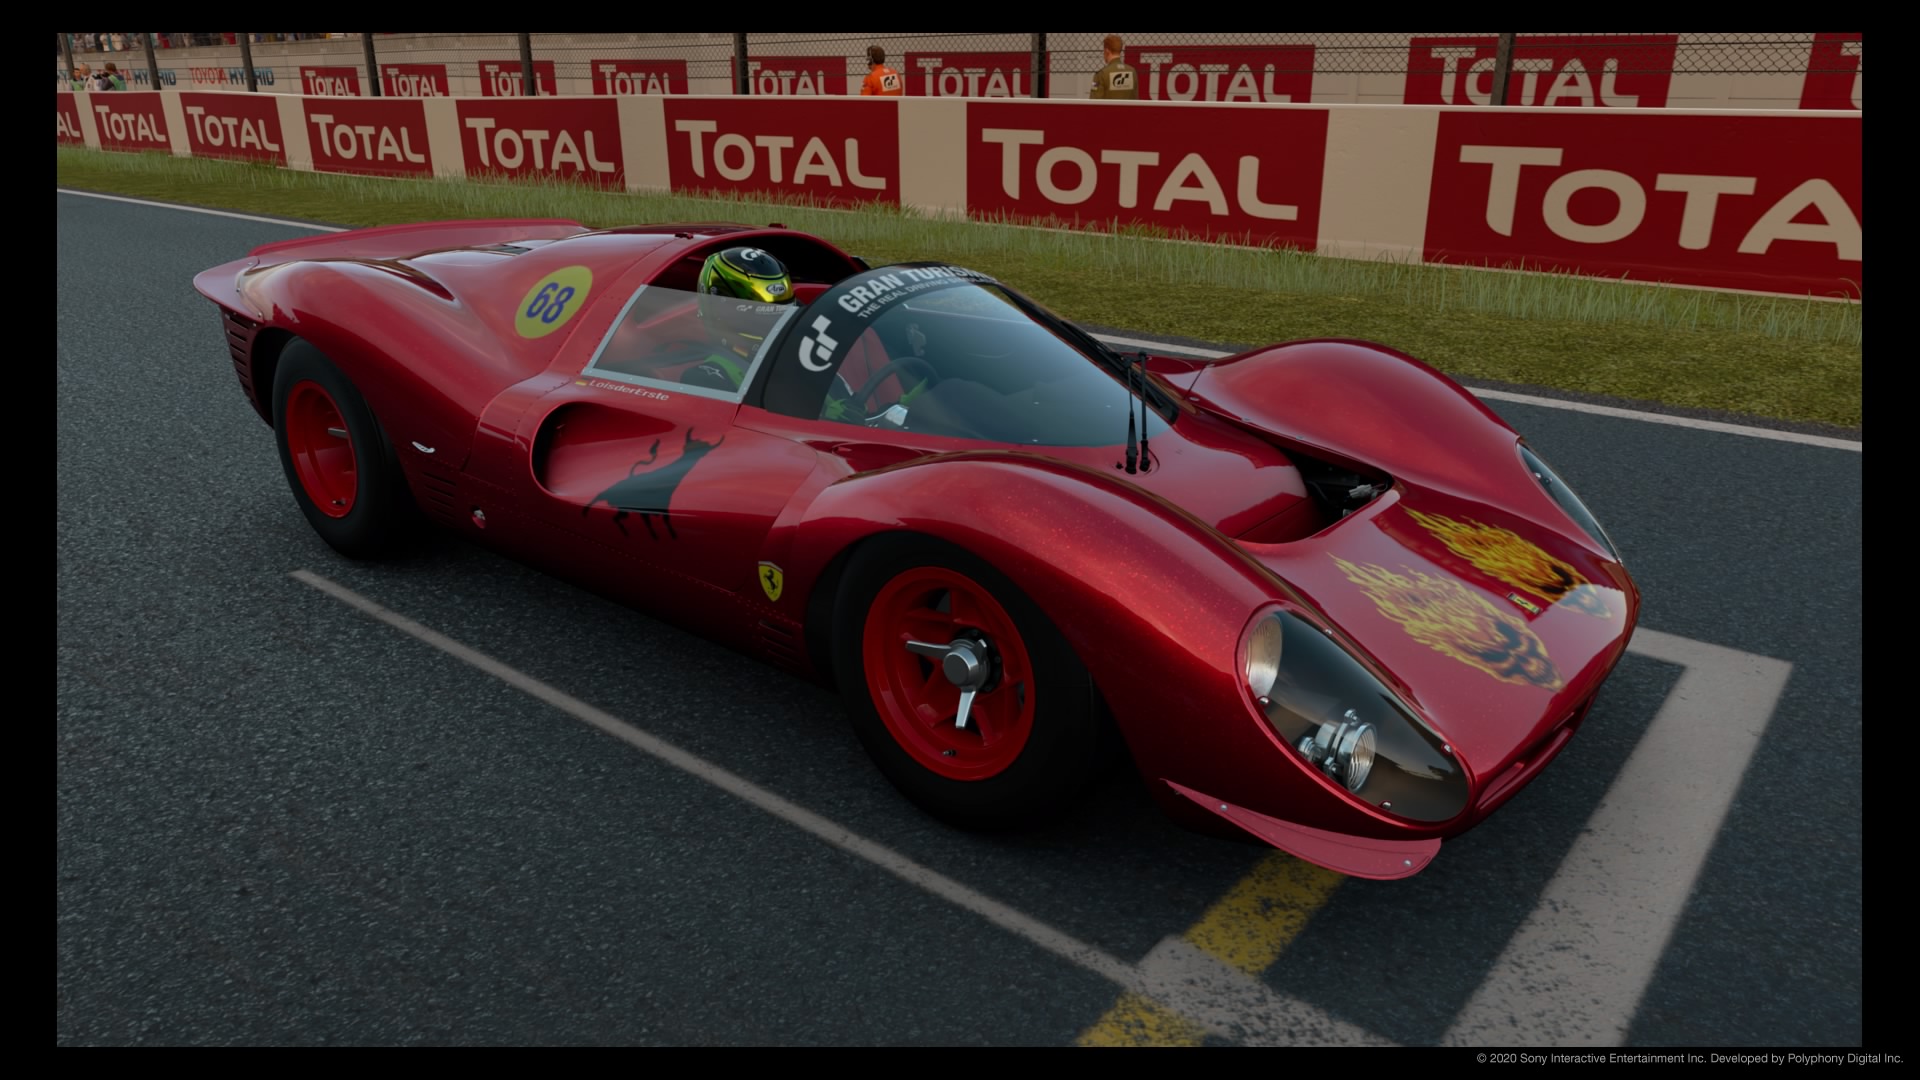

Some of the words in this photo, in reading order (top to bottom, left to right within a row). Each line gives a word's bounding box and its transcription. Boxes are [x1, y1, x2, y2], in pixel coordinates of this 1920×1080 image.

[133, 69, 177, 86] HYRID
[189, 67, 228, 85] TOYOTA
[228, 68, 275, 87] HYRID
[305, 70, 356, 97] TOTAL
[387, 68, 443, 97] TOTAL
[485, 64, 550, 97] TOTL
[599, 64, 672, 96] TOTAL
[748, 62, 834, 96] TOTAL
[917, 58, 1031, 98] TOTAL
[1140, 52, 1292, 103] TOTAL
[1431, 46, 1639, 108] TOTAL
[95, 105, 166, 142] TOTAL
[186, 106, 279, 152] TOTAL
[310, 114, 425, 164] TOTAL
[465, 118, 615, 173] TOTAL
[675, 120, 887, 190] TOTAL
[982, 128, 1298, 221] TOTAL
[526, 282, 575, 324] 68
[838, 273, 904, 313] GRAN
[900, 266, 999, 283] TURISM
[857, 304, 881, 318] THE
[880, 290, 908, 305] REAL
[905, 279, 949, 294] DRIVING
[589, 380, 669, 400] LoisderErste
